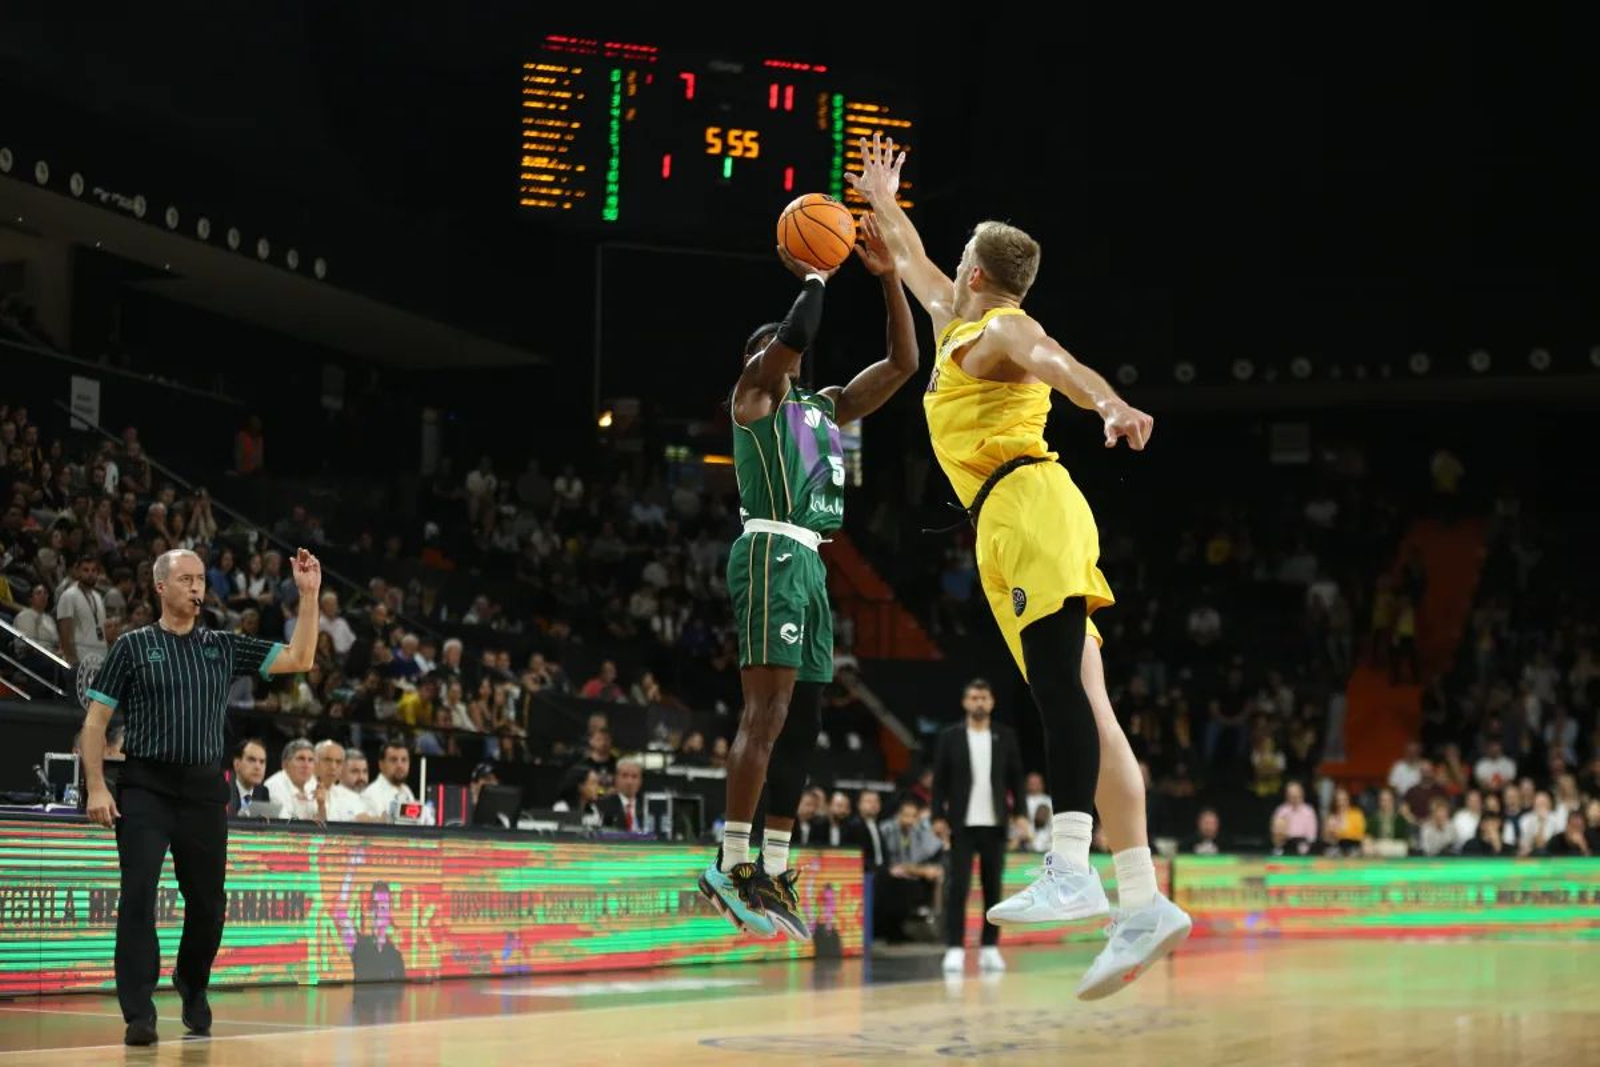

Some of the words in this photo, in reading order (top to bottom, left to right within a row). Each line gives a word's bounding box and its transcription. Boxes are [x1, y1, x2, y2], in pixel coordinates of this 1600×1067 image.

[680, 73, 696, 100] 7
[769, 83, 795, 111] 11
[662, 154, 672, 179] 1
[723, 157, 733, 178] 1
[784, 167, 794, 191] 1
[827, 455, 845, 486] 5
